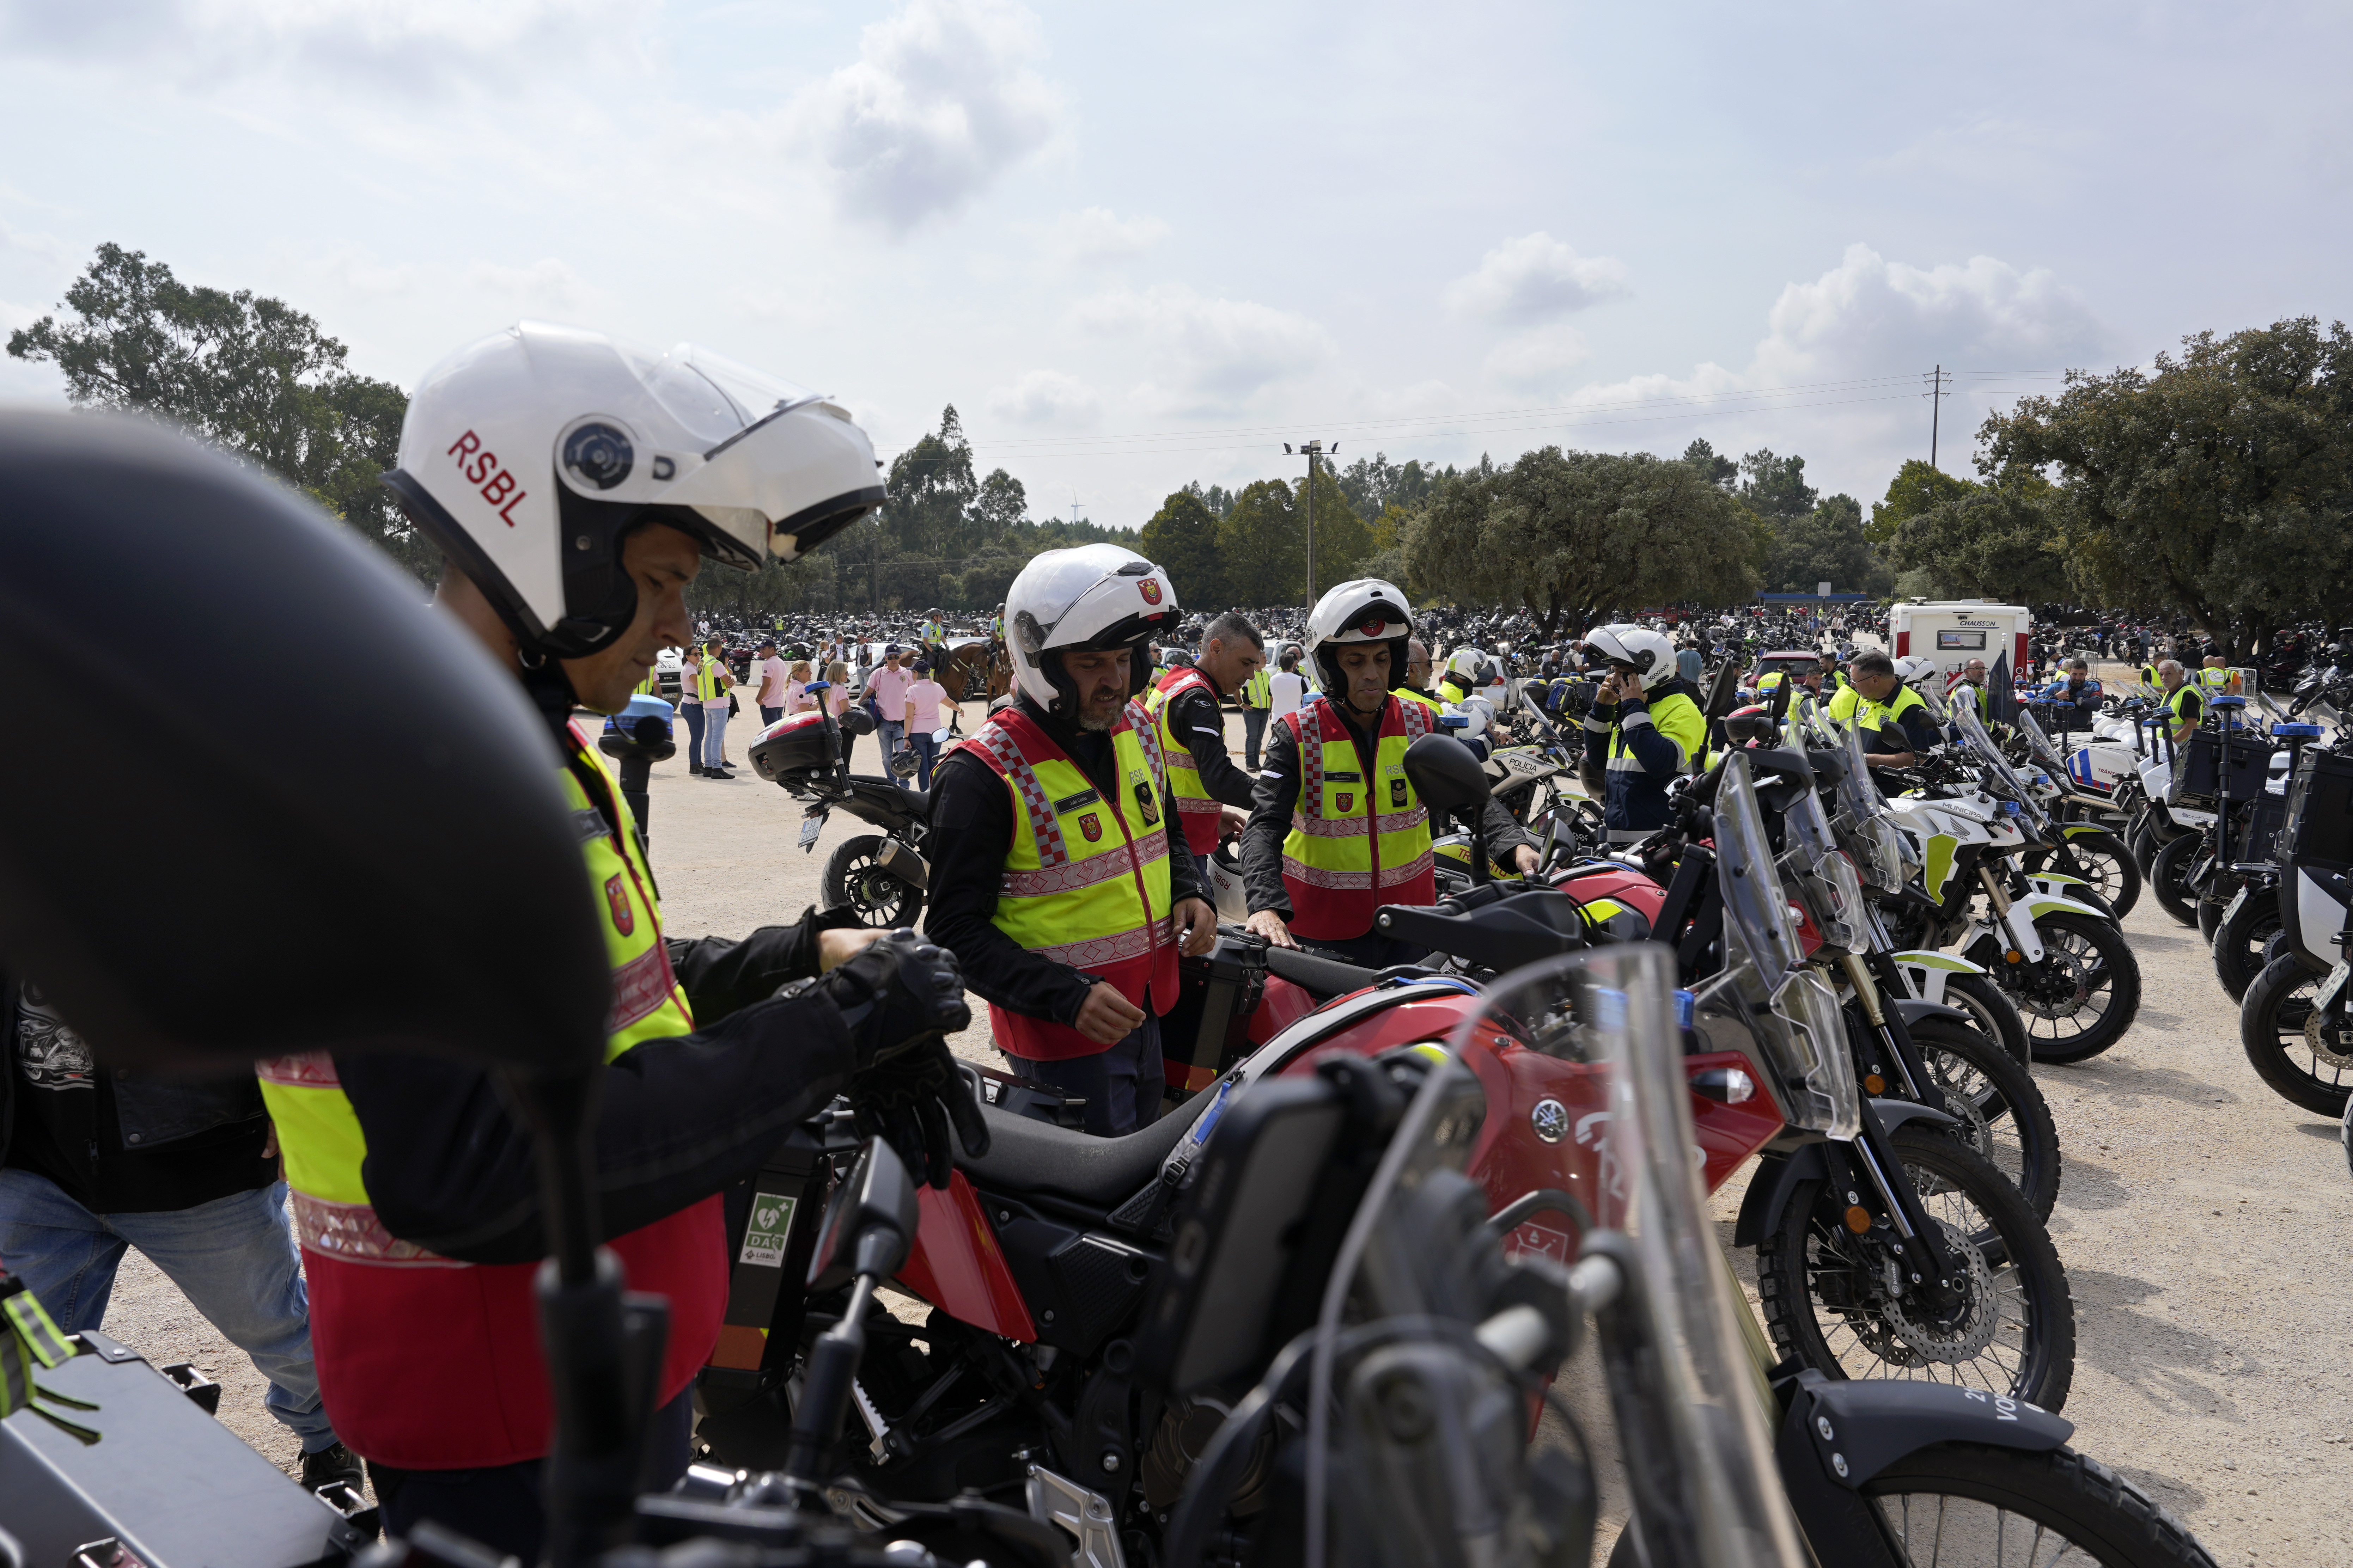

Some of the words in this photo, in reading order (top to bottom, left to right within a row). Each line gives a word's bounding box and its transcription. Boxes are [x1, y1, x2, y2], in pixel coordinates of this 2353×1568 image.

[448, 429, 526, 528] RSBL
[1509, 758, 1536, 772] POLÍCIA
[1512, 766, 1535, 776] MUNICIPAL
[1129, 768, 1145, 785] RSB
[1942, 802, 1986, 821] MUNICIPAL
[1944, 829, 1968, 841] HONDA
